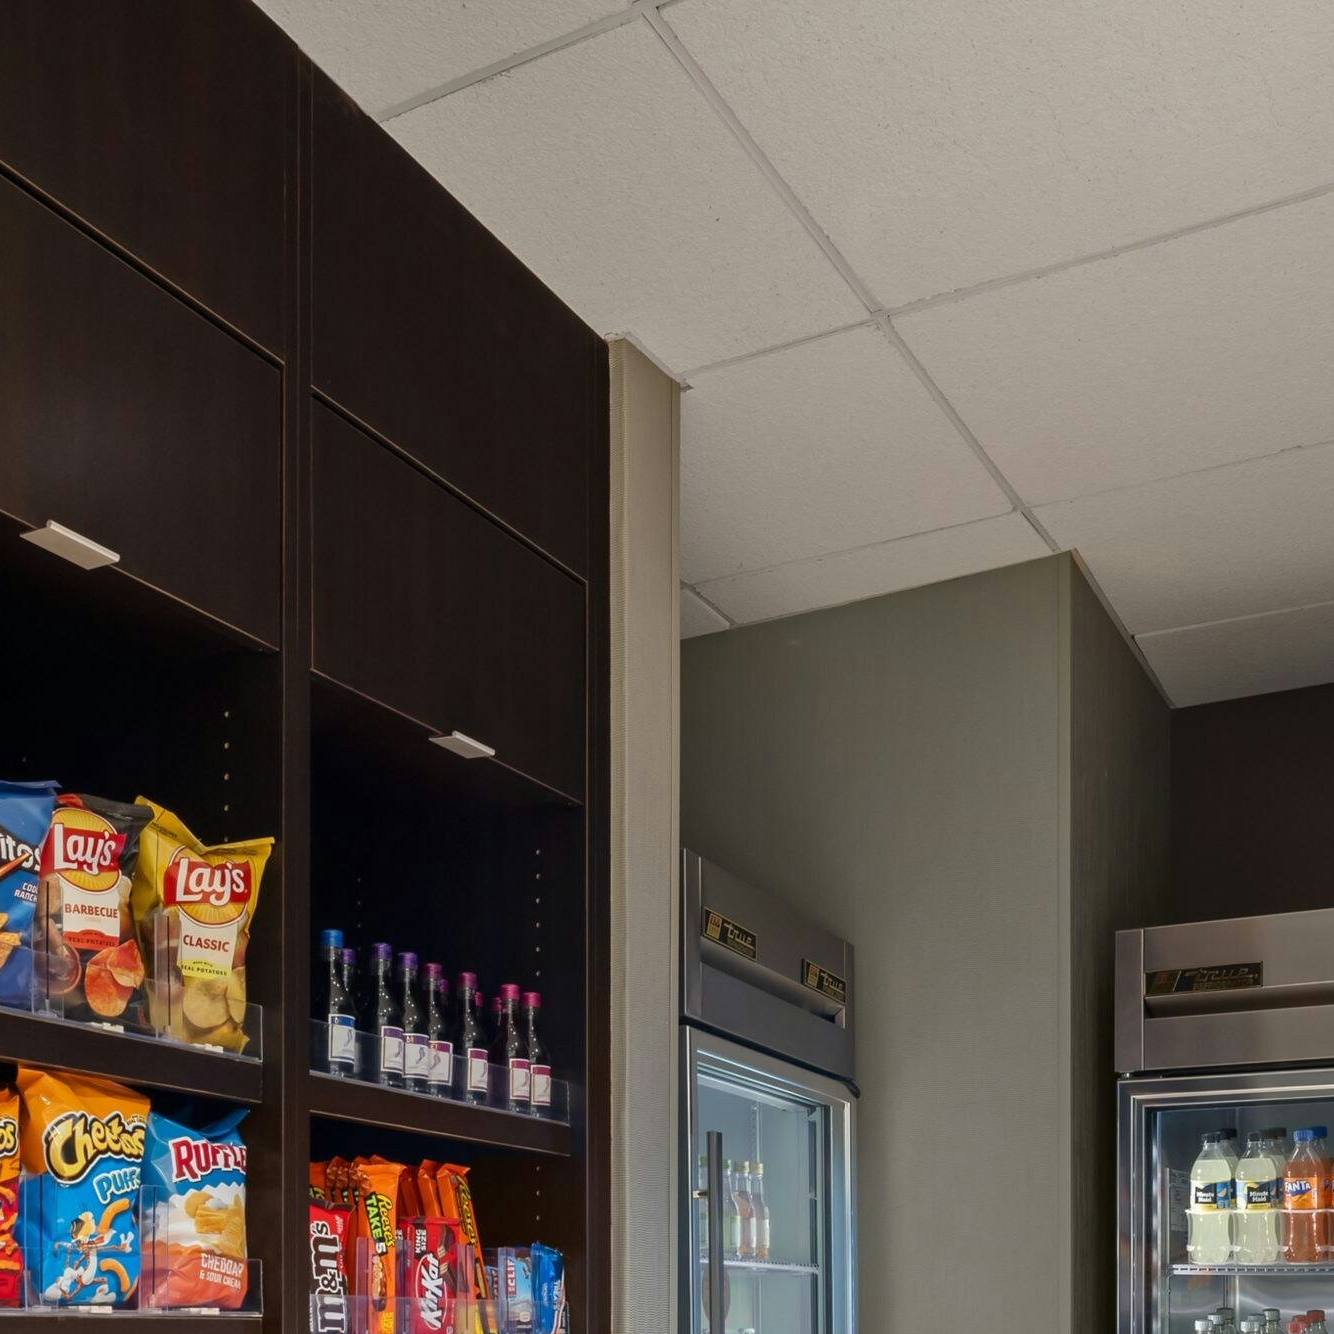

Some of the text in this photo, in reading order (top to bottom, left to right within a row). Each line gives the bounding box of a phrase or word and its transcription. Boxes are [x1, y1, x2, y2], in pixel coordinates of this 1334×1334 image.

[53, 823, 116, 875] Lay's
[176, 857, 245, 906] Lay's
[64, 903, 119, 919] BARBECUE
[183, 934, 230, 953] CLASSIC
[196, 966, 228, 977] POTATOES
[44, 1112, 145, 1182] Cheetos
[201, 1253, 243, 1276] CHEDDAR
